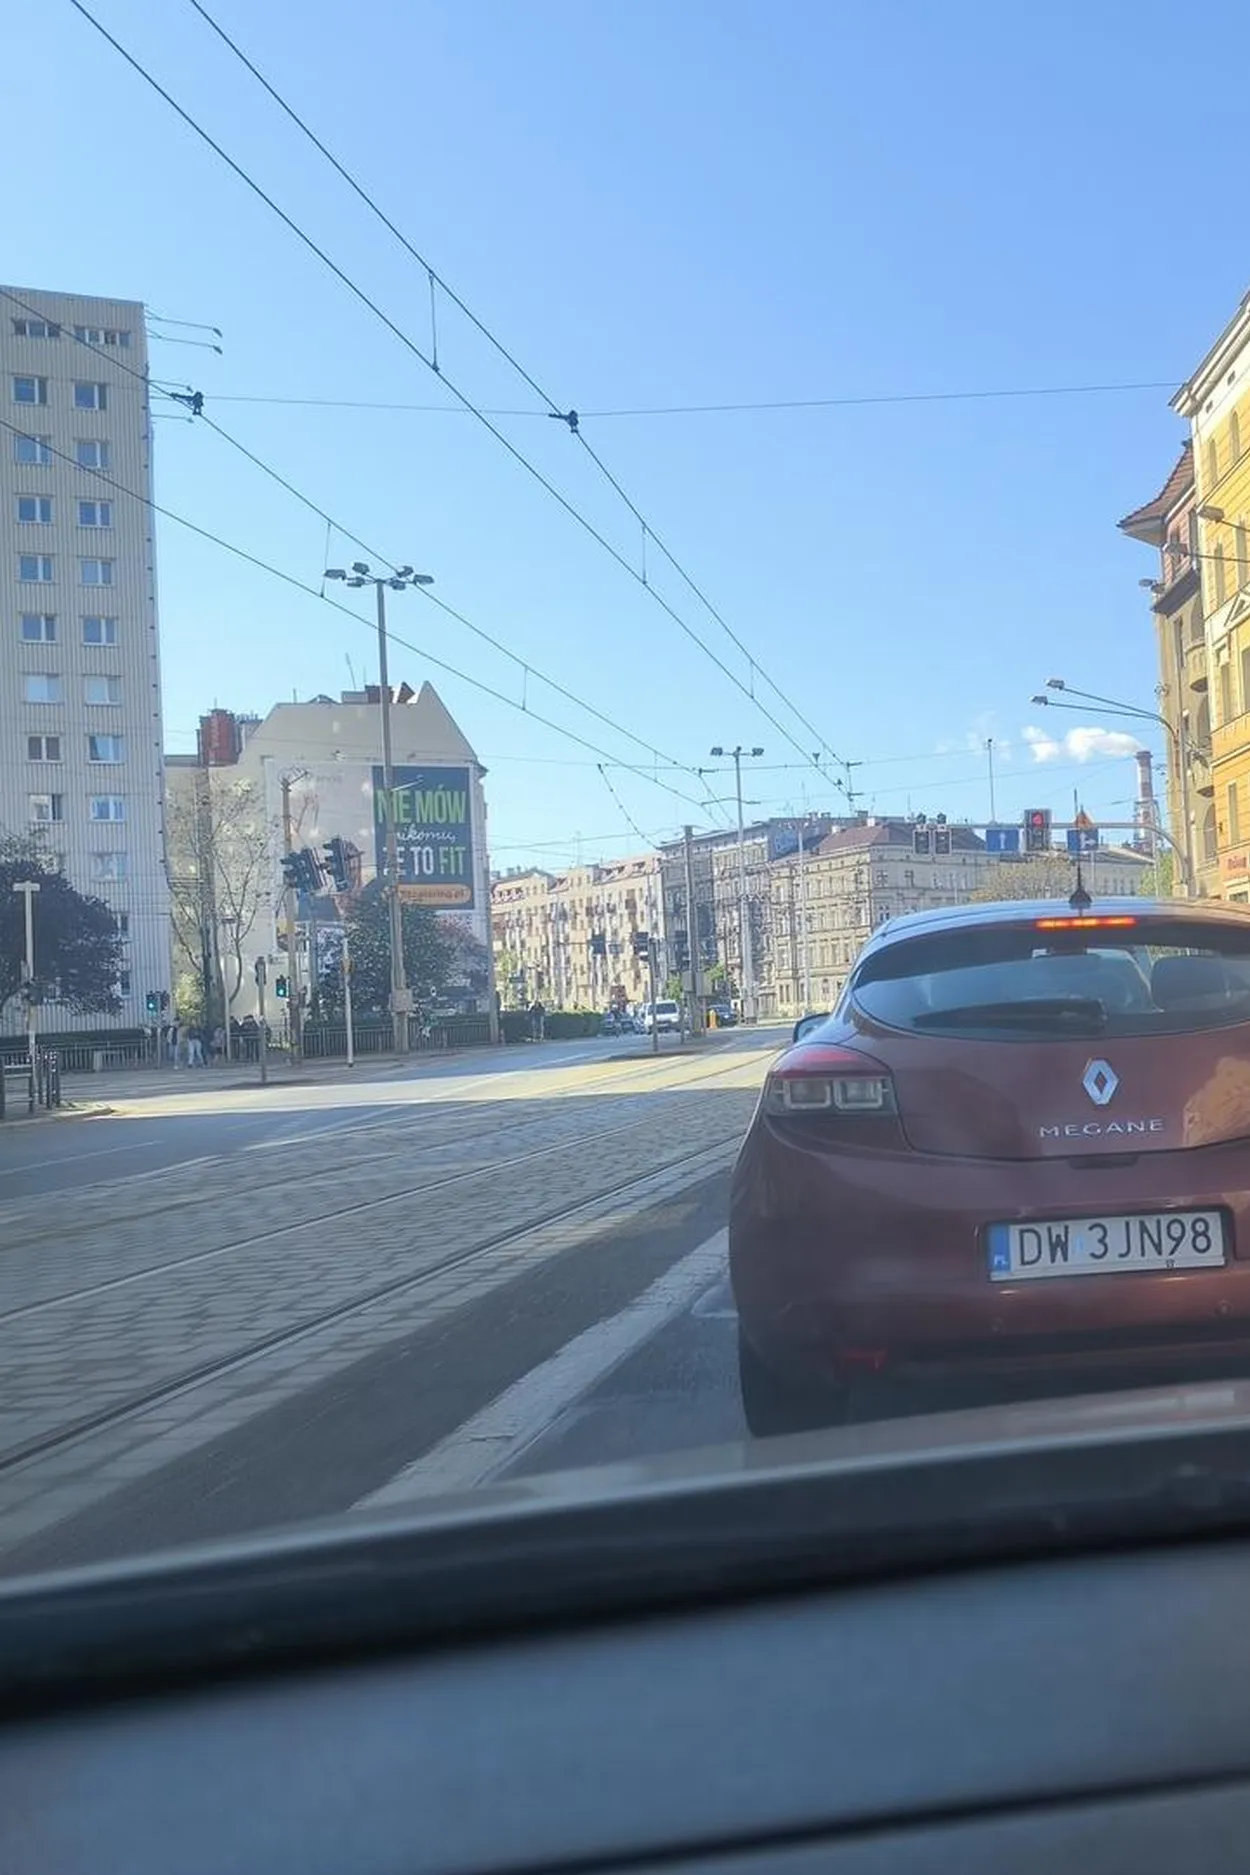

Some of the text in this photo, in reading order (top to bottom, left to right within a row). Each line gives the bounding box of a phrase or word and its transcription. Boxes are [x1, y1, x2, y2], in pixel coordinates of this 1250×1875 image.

[415, 784, 466, 823] MÓW
[410, 846, 435, 875] TO
[438, 846, 466, 876] FIT
[1039, 1119, 1164, 1138] MEGANE
[1018, 1224, 1069, 1266] DW
[1087, 1217, 1212, 1262] 3JN98
